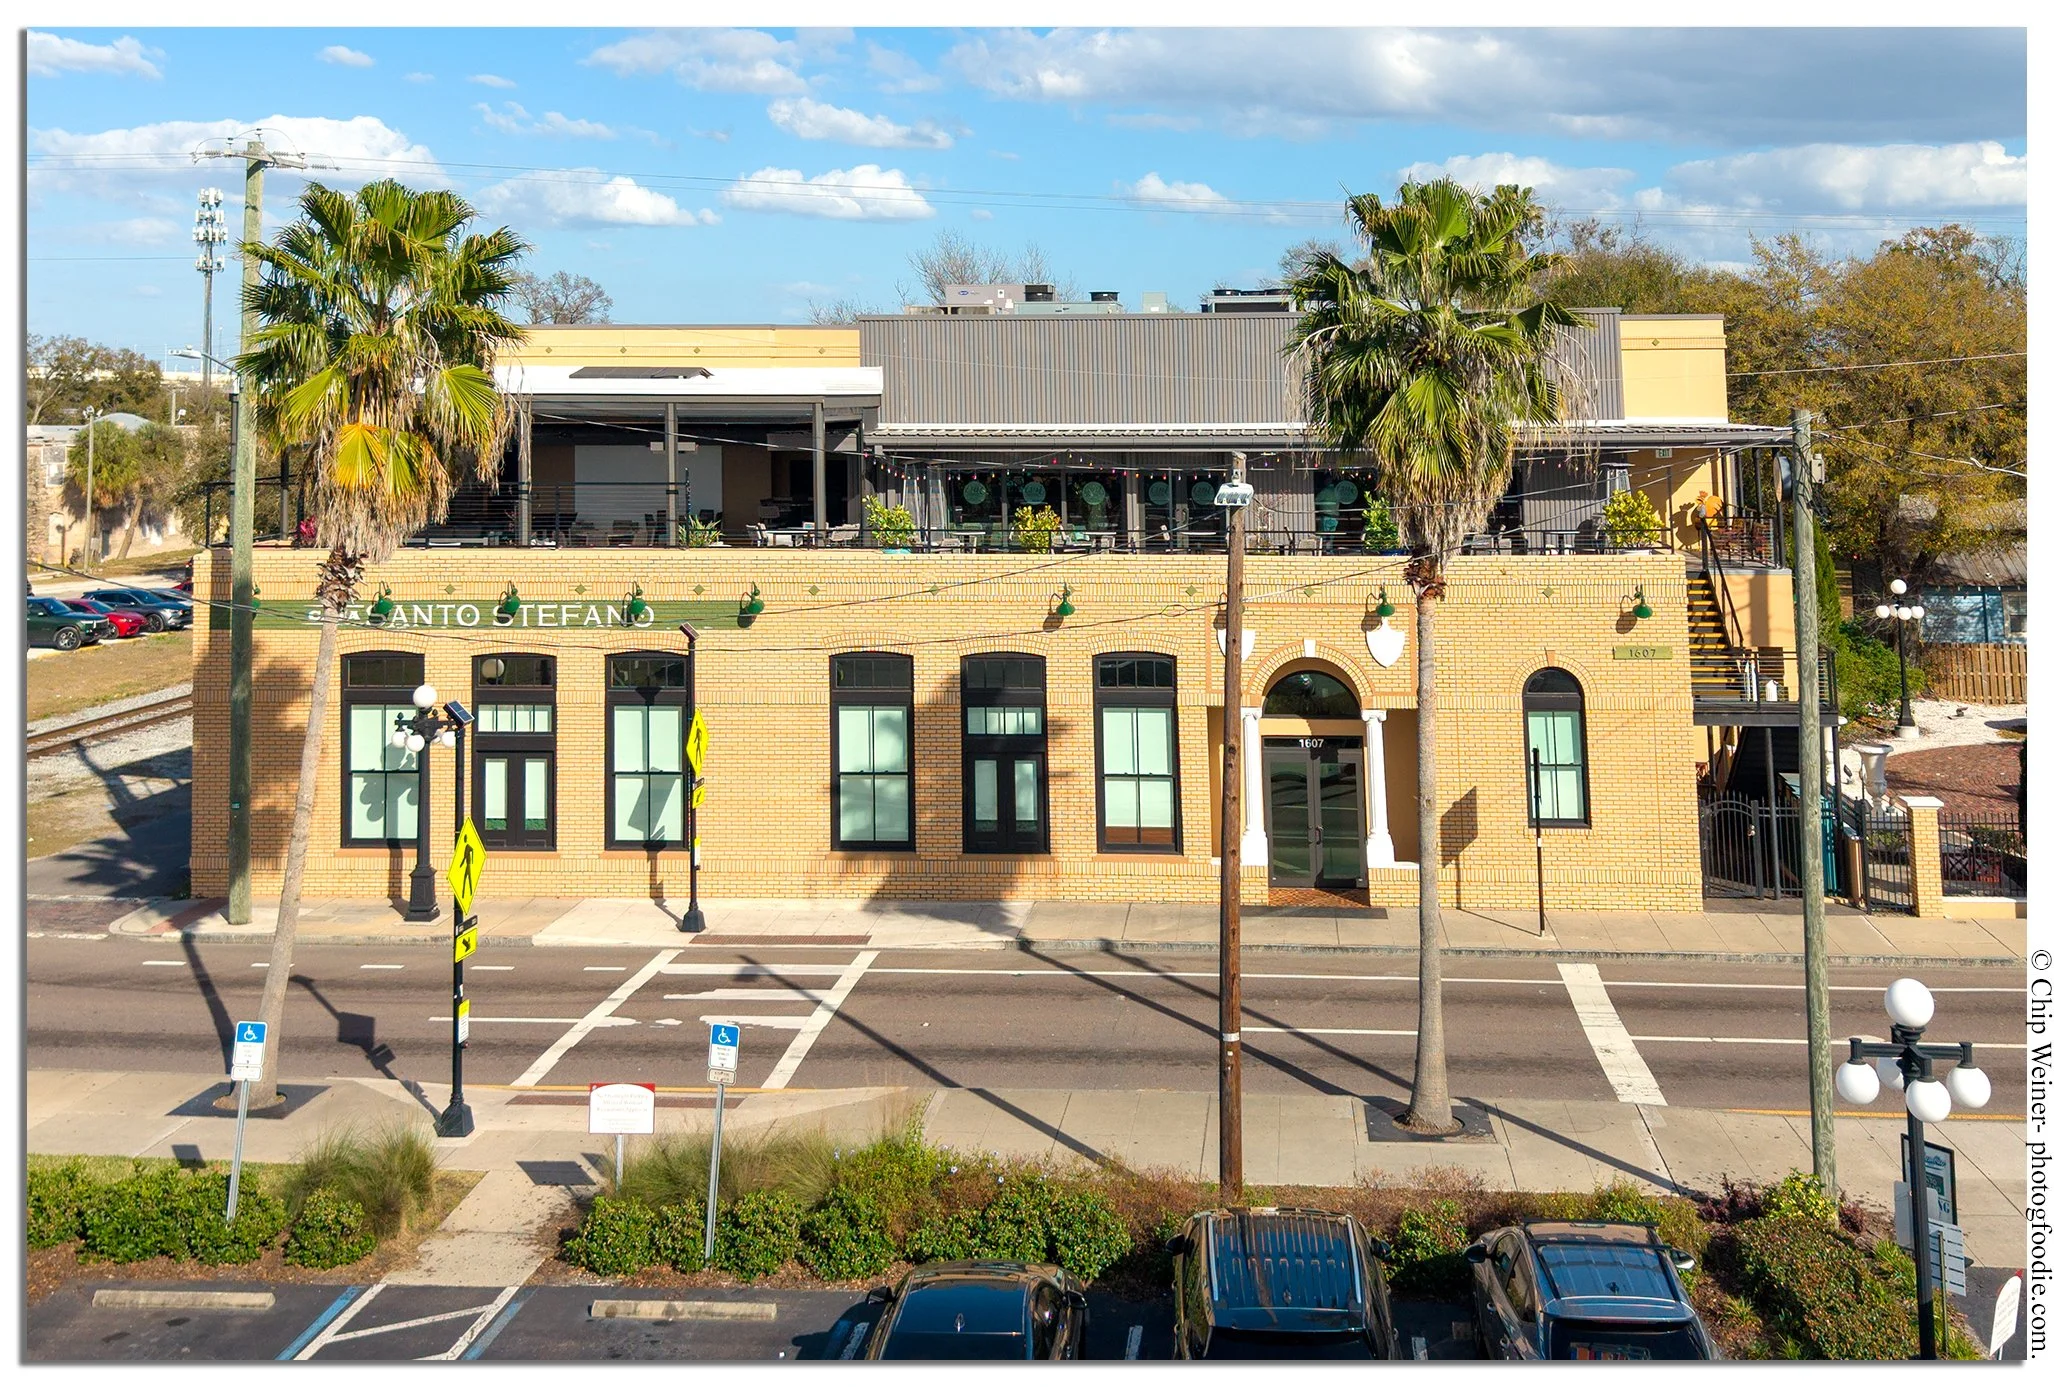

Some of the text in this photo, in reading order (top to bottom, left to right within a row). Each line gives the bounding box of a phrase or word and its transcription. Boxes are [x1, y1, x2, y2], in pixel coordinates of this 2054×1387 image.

[1658, 448, 1670, 457] EXIT
[365, 604, 480, 628] SANTO
[492, 604, 655, 628] STEFANO
[1629, 648, 1656, 658] 1607
[1298, 738, 1324, 748] 1607
